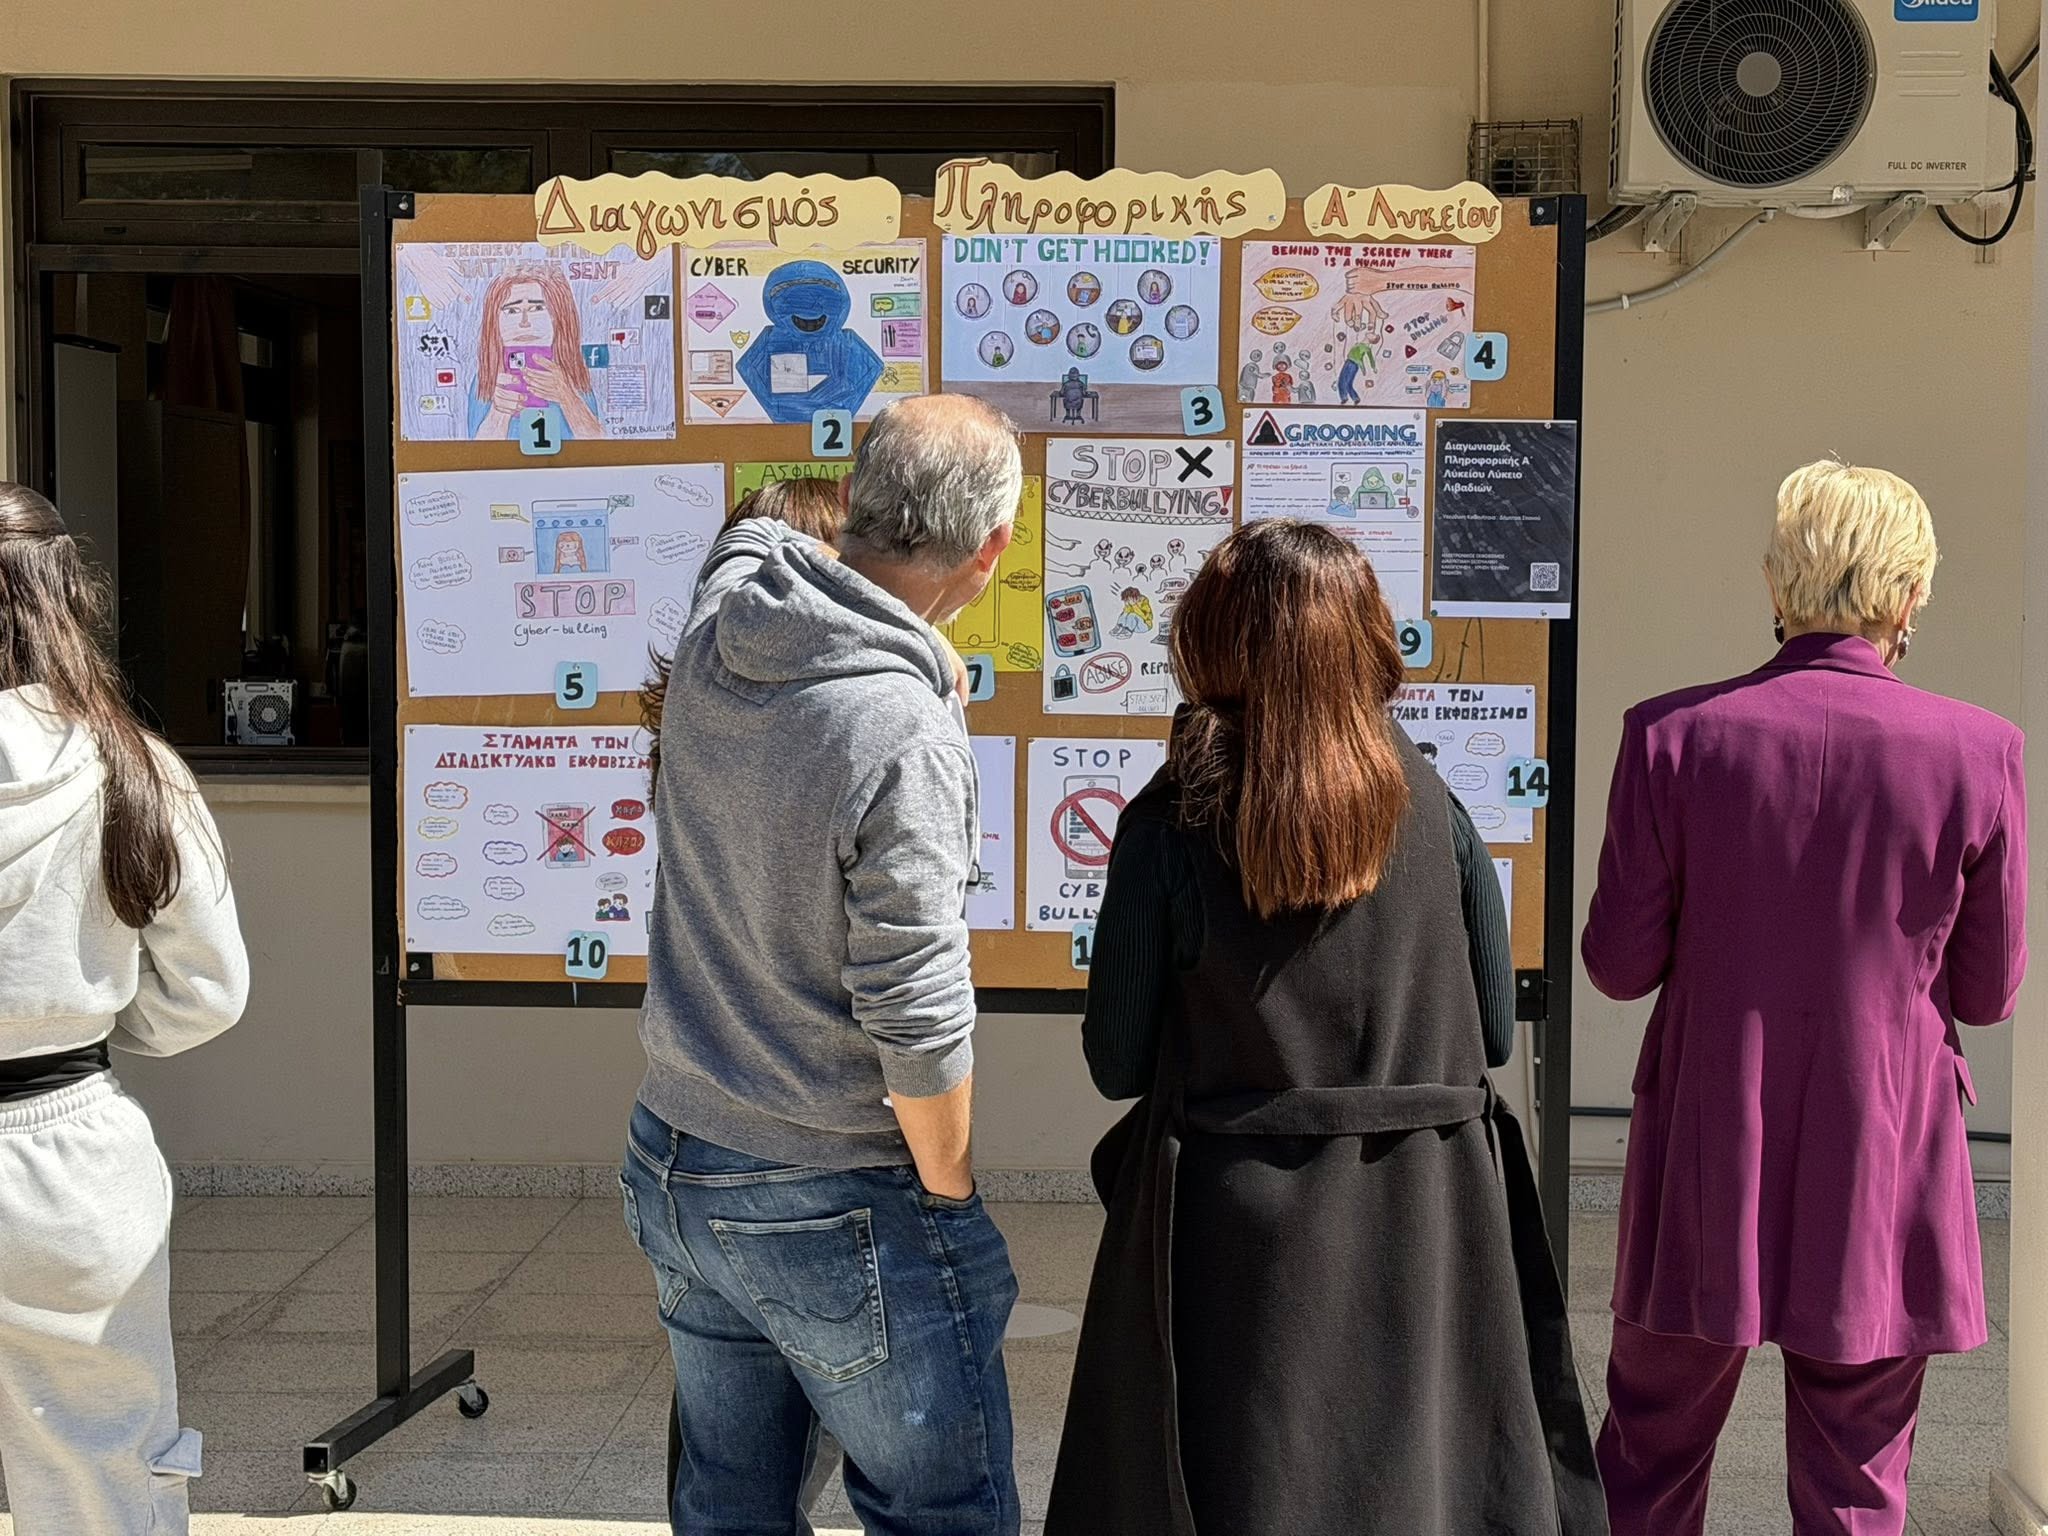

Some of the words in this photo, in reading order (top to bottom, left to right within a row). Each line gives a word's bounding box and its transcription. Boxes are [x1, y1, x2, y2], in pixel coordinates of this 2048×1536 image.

[1888, 161, 1907, 170] FULL
[1910, 161, 1923, 170] DC
[1926, 161, 1967, 170] INVERTER
[539, 175, 839, 260] Διαγωνισμός
[1367, 187, 1500, 233] Λυκείου
[954, 237, 1028, 264] DON'T
[1037, 238, 1089, 263] GET
[1093, 239, 1212, 266] HOOKED!
[1271, 245, 1320, 257] BEHIND
[1325, 245, 1353, 257] THE
[1362, 246, 1412, 258] SCREEN
[1417, 248, 1455, 259] THERE
[1324, 256, 1337, 267] IS
[1343, 256, 1351, 267] A
[1355, 257, 1397, 268] HUMAN
[569, 261, 620, 280] SENT
[690, 256, 749, 276] CYBER
[842, 257, 921, 275] SECURITY
[1403, 311, 1431, 333] STOP
[1474, 340, 1496, 369] 4
[1191, 396, 1213, 426] 3
[530, 418, 551, 448] 1
[821, 419, 843, 450] 2
[1284, 423, 1417, 442] GROOMING
[1444, 441, 1511, 452] Διαγωνισμός
[1071, 445, 1172, 486] STOP
[1444, 455, 1519, 467] Πληροφορικής
[760, 463, 848, 486] ΑΣΦΑΛΕΙ
[1487, 469, 1523, 479] Λύκειο
[1048, 480, 1233, 516] CYBERBULLYING!
[1443, 482, 1493, 494] Λιβαδιών
[520, 583, 627, 618] STOP
[1400, 627, 1422, 656] 9
[967, 664, 982, 694] 7
[1086, 659, 1128, 687] ABUSE
[1141, 662, 1174, 676] REPO
[563, 672, 584, 701] 5
[1448, 688, 1484, 703] ΤΟΝ
[1435, 706, 1528, 721] ΕΚΦΟΒΙΣΜΟ
[482, 733, 578, 750] ΣΤΑΜΑΤΑ
[591, 736, 629, 750] ΤΟΝ
[435, 752, 556, 769] ΔΙΑΔΙΚΤΥΑΚΟ
[569, 755, 651, 770] ΕΚΦΟΒΙΣΜ
[1053, 746, 1132, 769] STOP
[1507, 766, 1549, 797] 14
[1059, 882, 1101, 899] CYB
[568, 937, 605, 969] 10
[1074, 935, 1091, 966] 1
